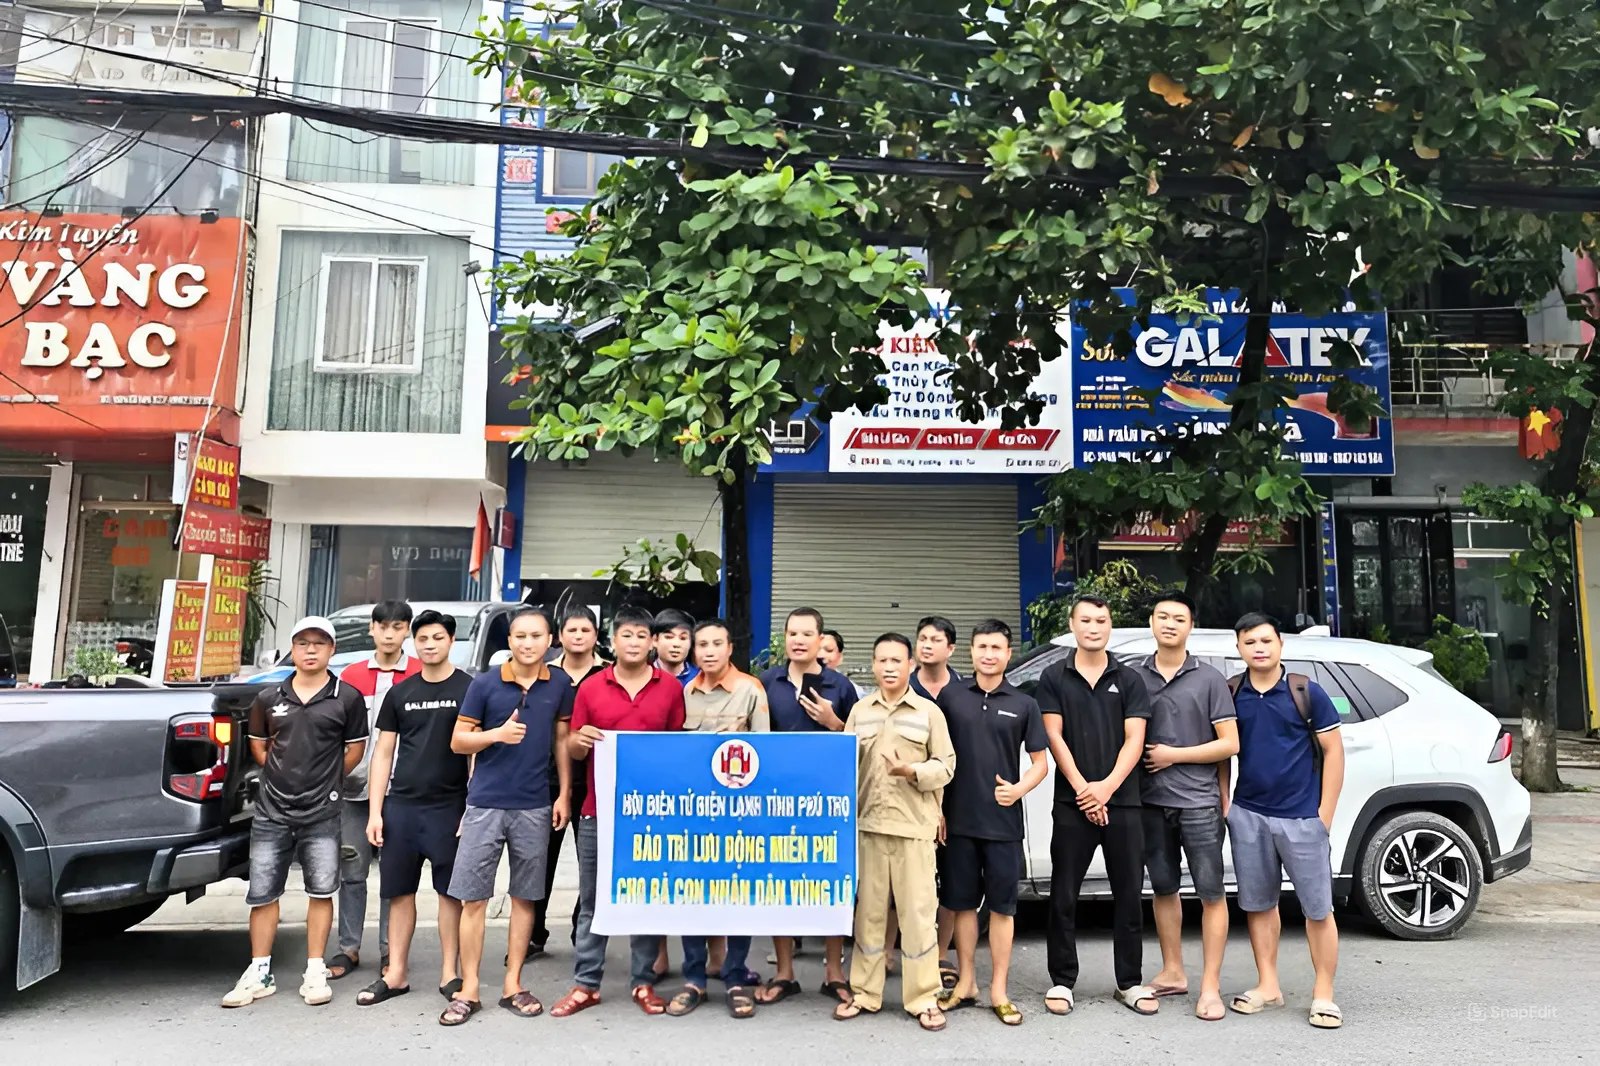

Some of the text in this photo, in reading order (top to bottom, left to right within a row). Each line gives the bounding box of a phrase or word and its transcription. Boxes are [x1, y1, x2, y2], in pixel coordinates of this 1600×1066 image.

[0, 219, 53, 241] Kim
[2, 247, 209, 308] VÀNG
[21, 321, 176, 379] BẠC
[892, 361, 919, 372] Can
[729, 795, 762, 821] LẠNH
[826, 795, 851, 823] THỌ
[632, 824, 662, 862] BẢO
[693, 832, 720, 863] LƯU
[725, 829, 766, 870] ĐỘNG
[812, 830, 838, 863] PHÍ
[616, 877, 646, 905] CHO
[673, 877, 705, 905] CON
[708, 872, 751, 905] NHÂN
[789, 872, 831, 905] VÙNG
